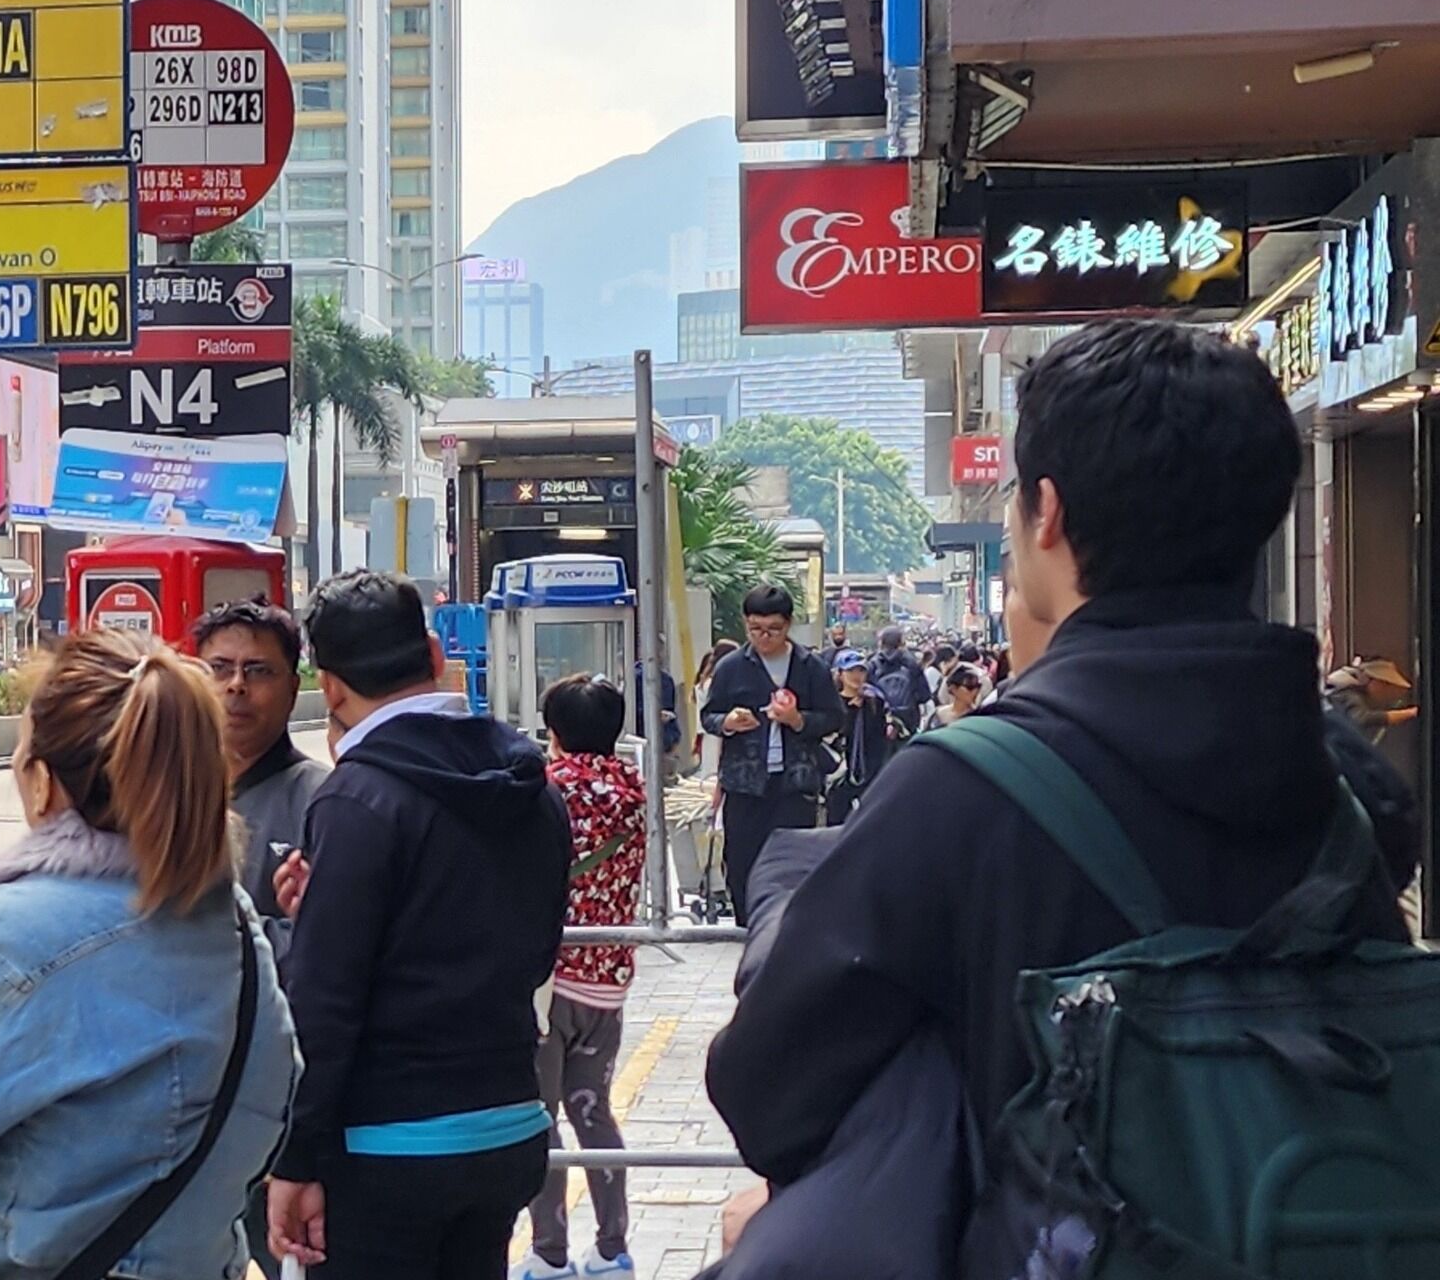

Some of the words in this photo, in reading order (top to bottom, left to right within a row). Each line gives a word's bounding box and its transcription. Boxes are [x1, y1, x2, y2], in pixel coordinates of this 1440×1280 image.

[150, 24, 203, 48] KMB
[154, 57, 195, 85] 26X
[217, 56, 258, 84] 98D
[150, 95, 202, 122] 296D
[209, 92, 262, 122] N213
[137, 169, 184, 189] 轉車站
[201, 168, 243, 188] 海防道
[222, 188, 247, 201] ROAD
[40, 247, 57, 268] O
[994, 216, 1235, 280] 名錶維修
[255, 266, 286, 280] KMB
[50, 283, 120, 337] N796
[197, 338, 256, 355] Platform
[130, 368, 219, 426] N4
